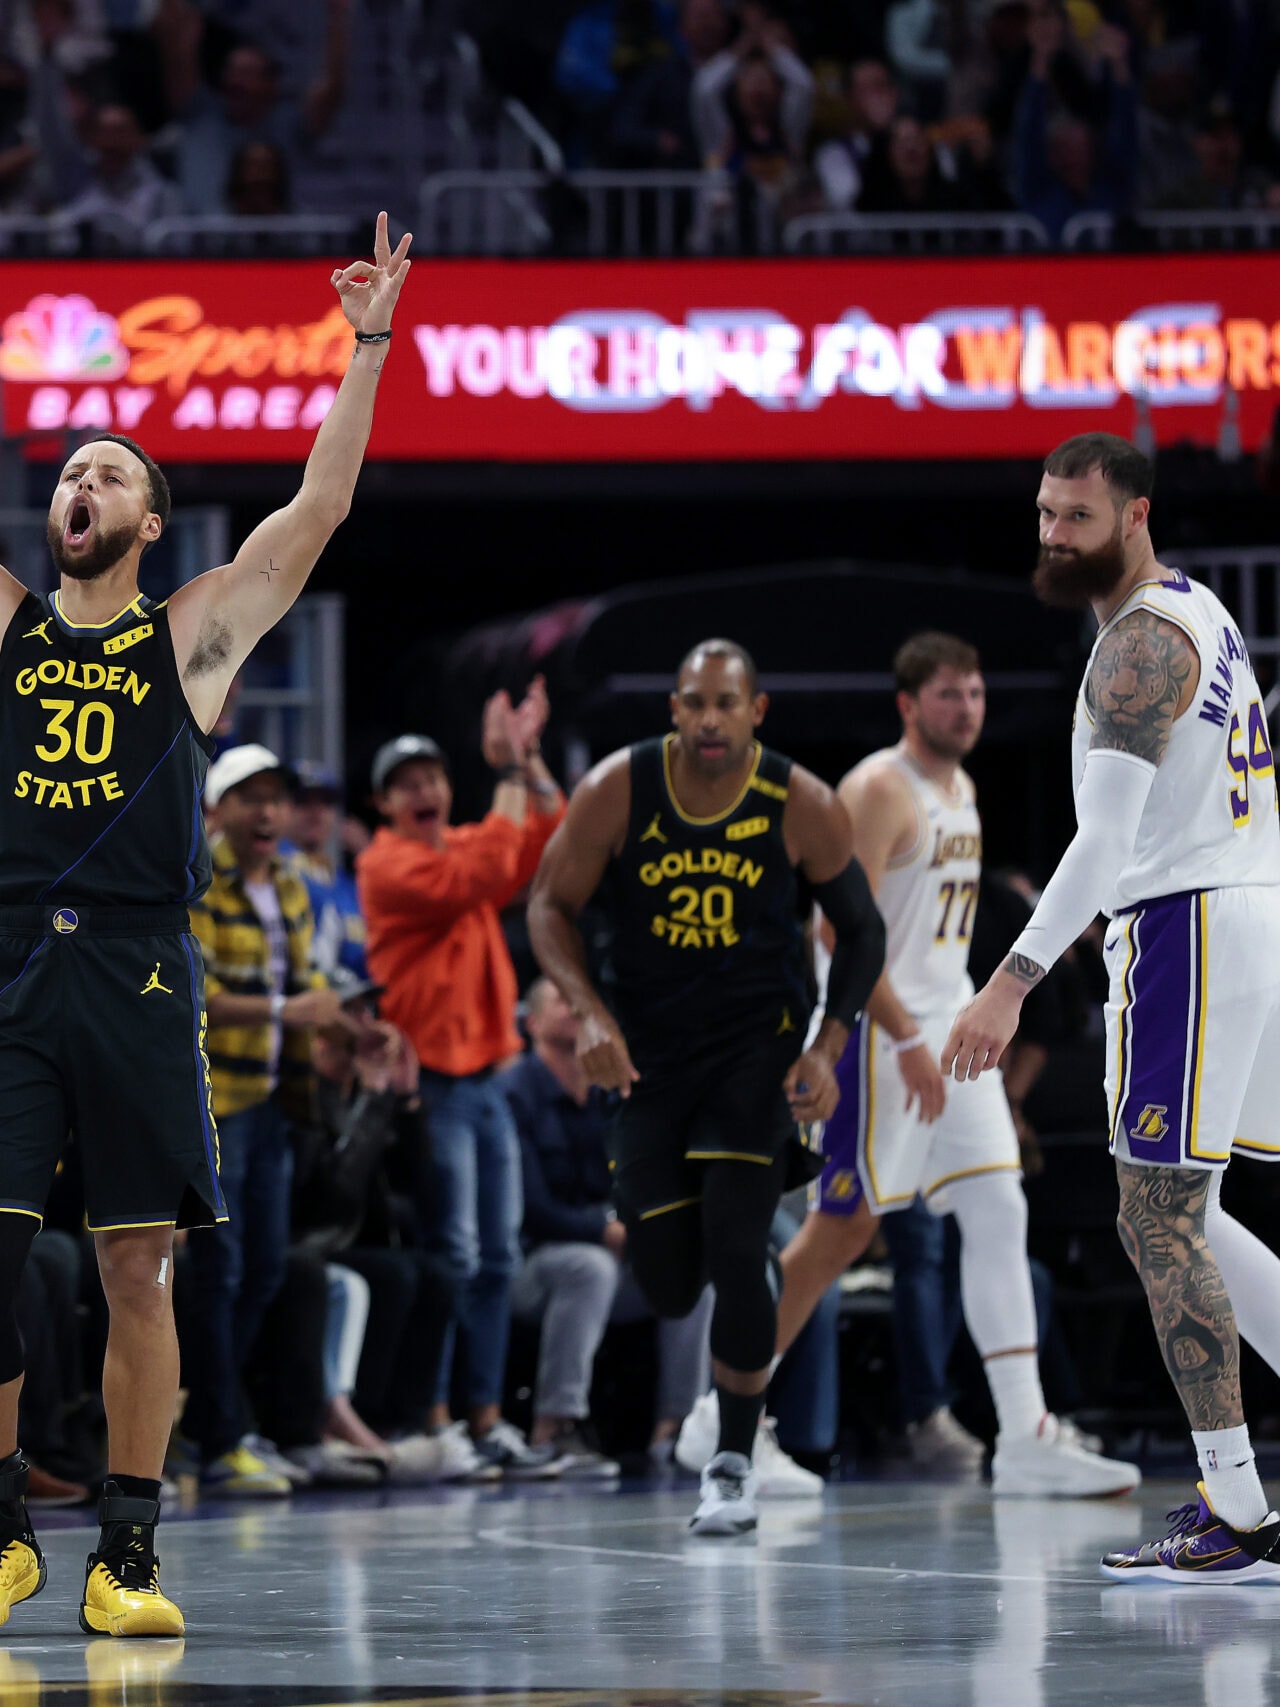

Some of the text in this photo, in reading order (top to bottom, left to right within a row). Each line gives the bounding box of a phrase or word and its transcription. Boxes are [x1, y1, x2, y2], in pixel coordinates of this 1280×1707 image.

[414, 324, 598, 398] YOUR
[813, 322, 947, 397] FOR
[955, 319, 1280, 394] WARRIOR
[28, 386, 155, 430] BAY
[107, 626, 149, 652] IREN
[15, 659, 152, 706] GOLDEN
[34, 698, 115, 765] 30
[1226, 698, 1276, 829] 54
[14, 770, 125, 809] STATE
[639, 848, 764, 888] GOLDEN
[668, 884, 734, 927] 20
[934, 880, 980, 945] 77
[650, 914, 740, 949] STATE
